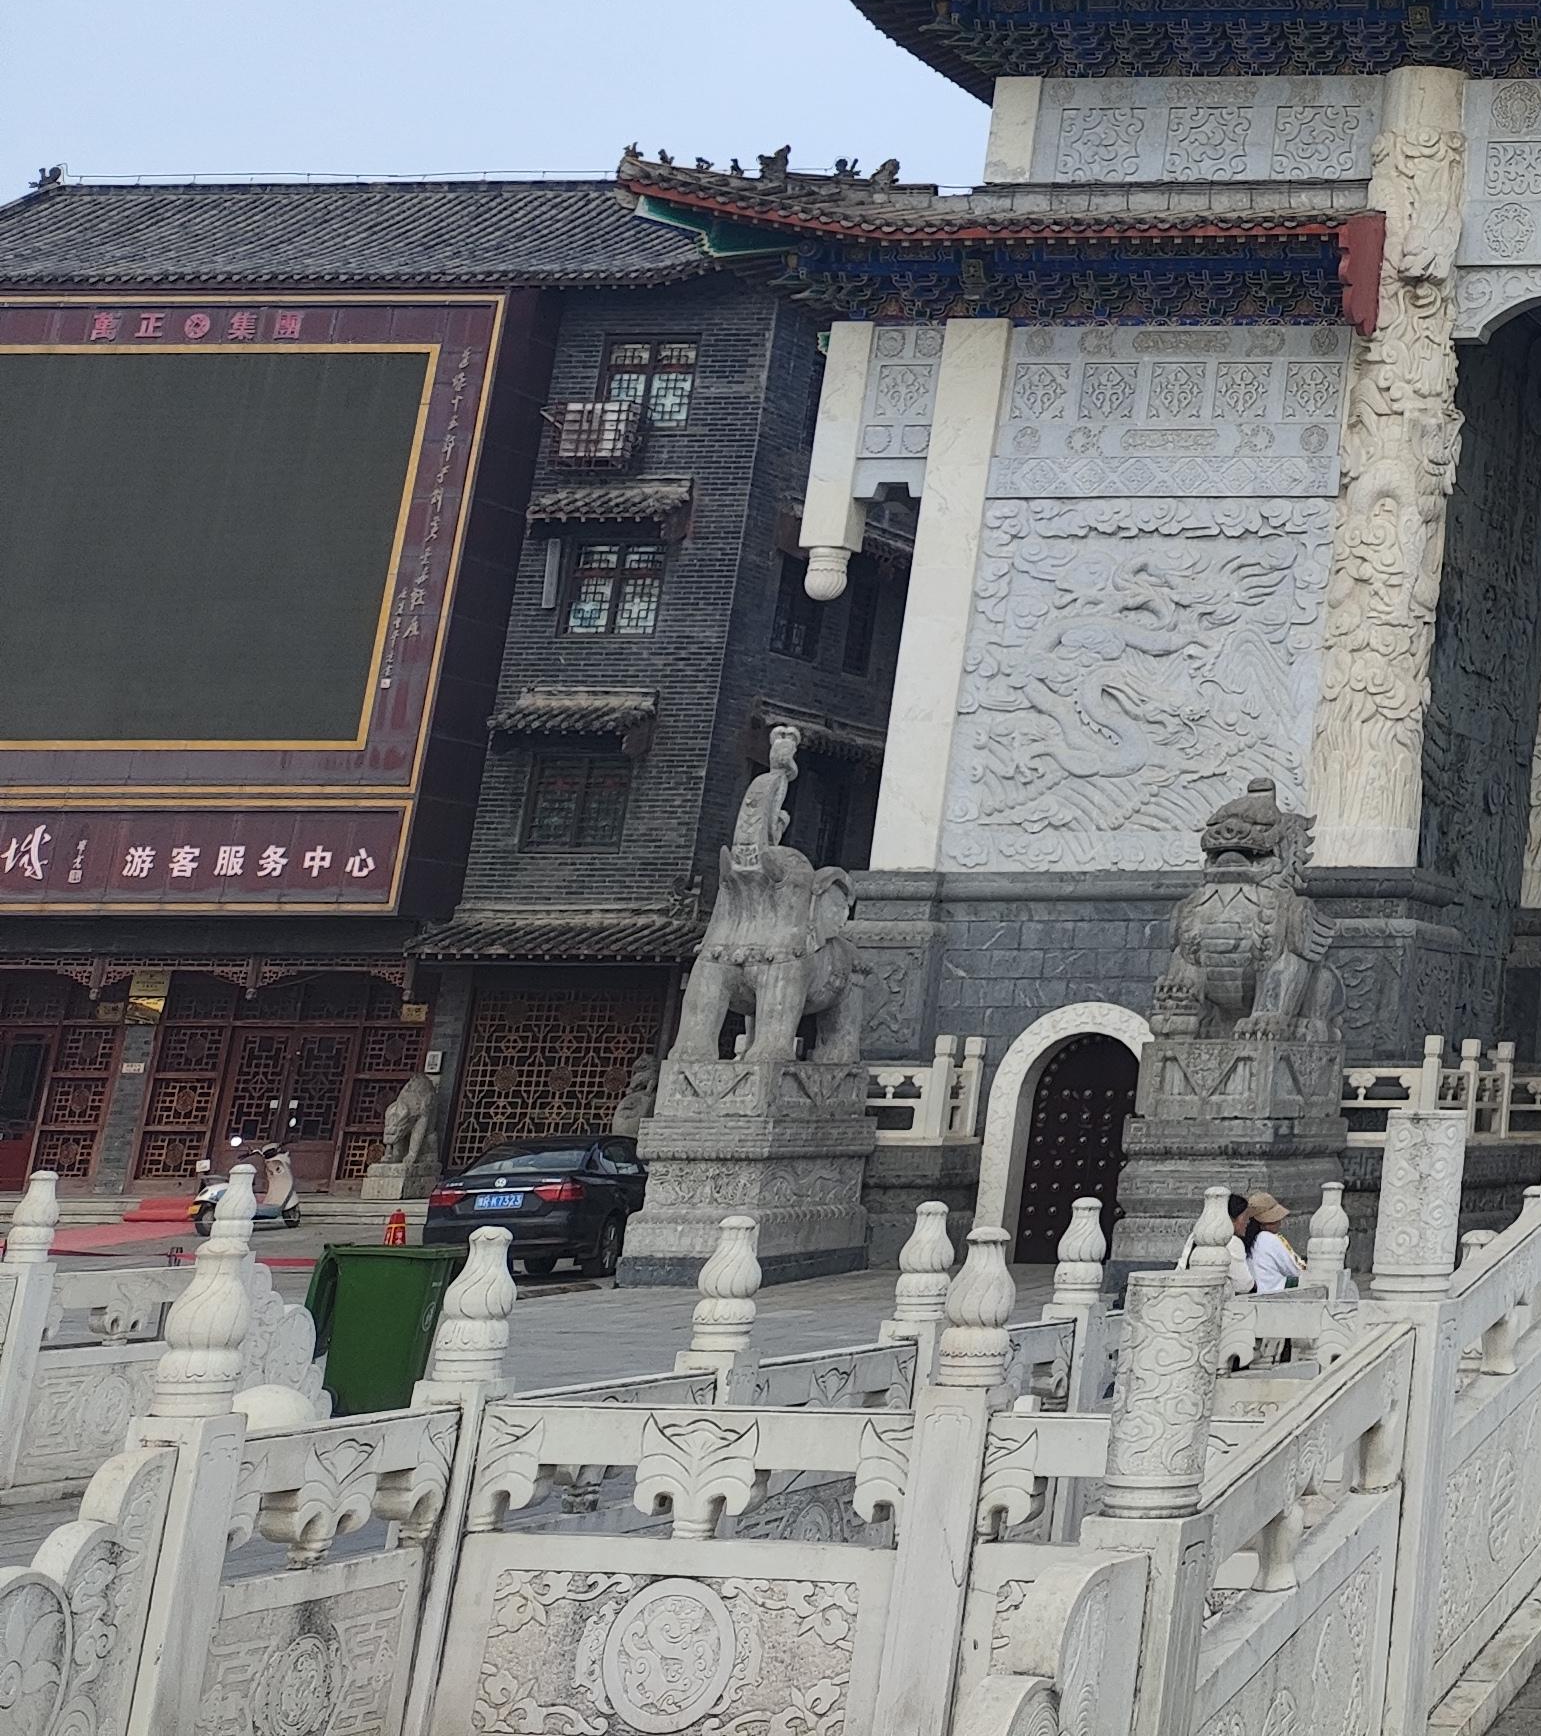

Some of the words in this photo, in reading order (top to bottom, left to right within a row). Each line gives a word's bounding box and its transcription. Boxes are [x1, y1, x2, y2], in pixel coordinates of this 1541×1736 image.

[122, 844, 376, 879] 游客服务中心
